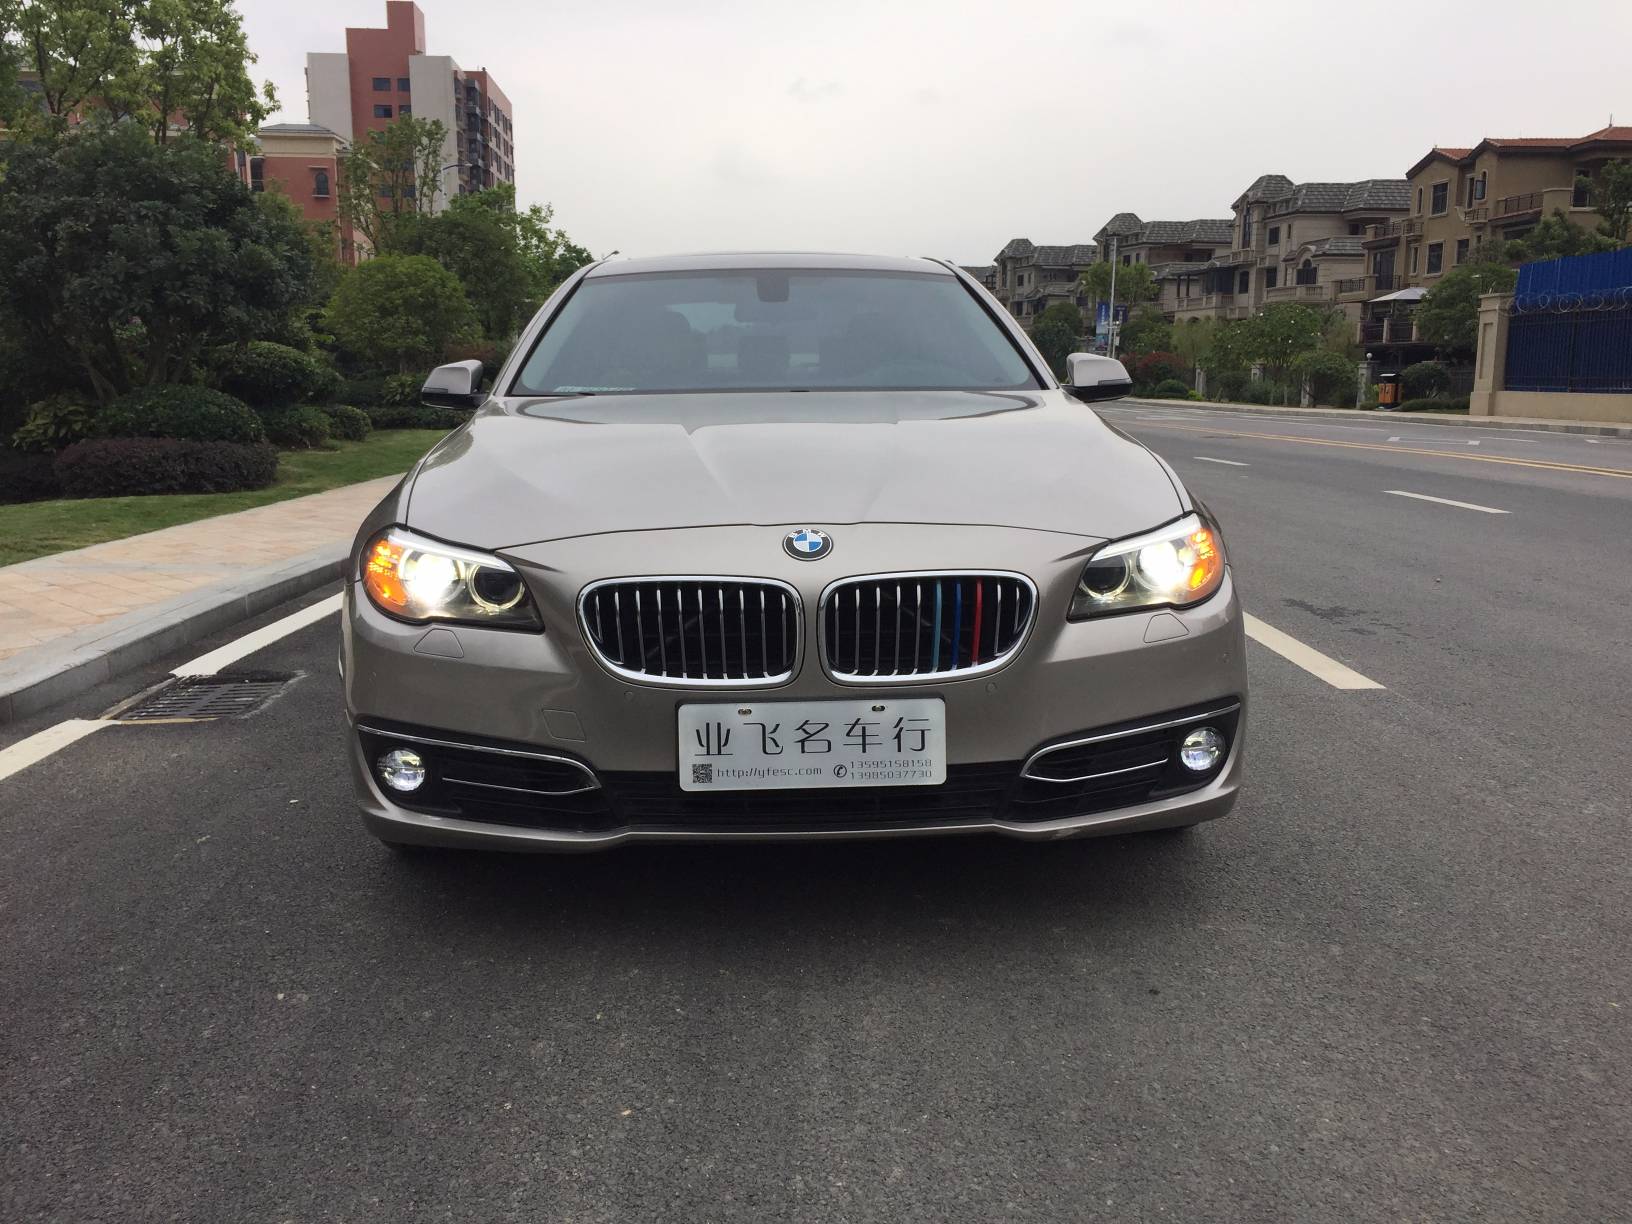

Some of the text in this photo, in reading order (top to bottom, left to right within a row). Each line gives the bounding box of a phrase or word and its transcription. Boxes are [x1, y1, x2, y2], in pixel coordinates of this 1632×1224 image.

[694, 717, 932, 756] 业飞名车行
[850, 759, 932, 768] 13595158158
[716, 767, 822, 778] http://yfesc.com
